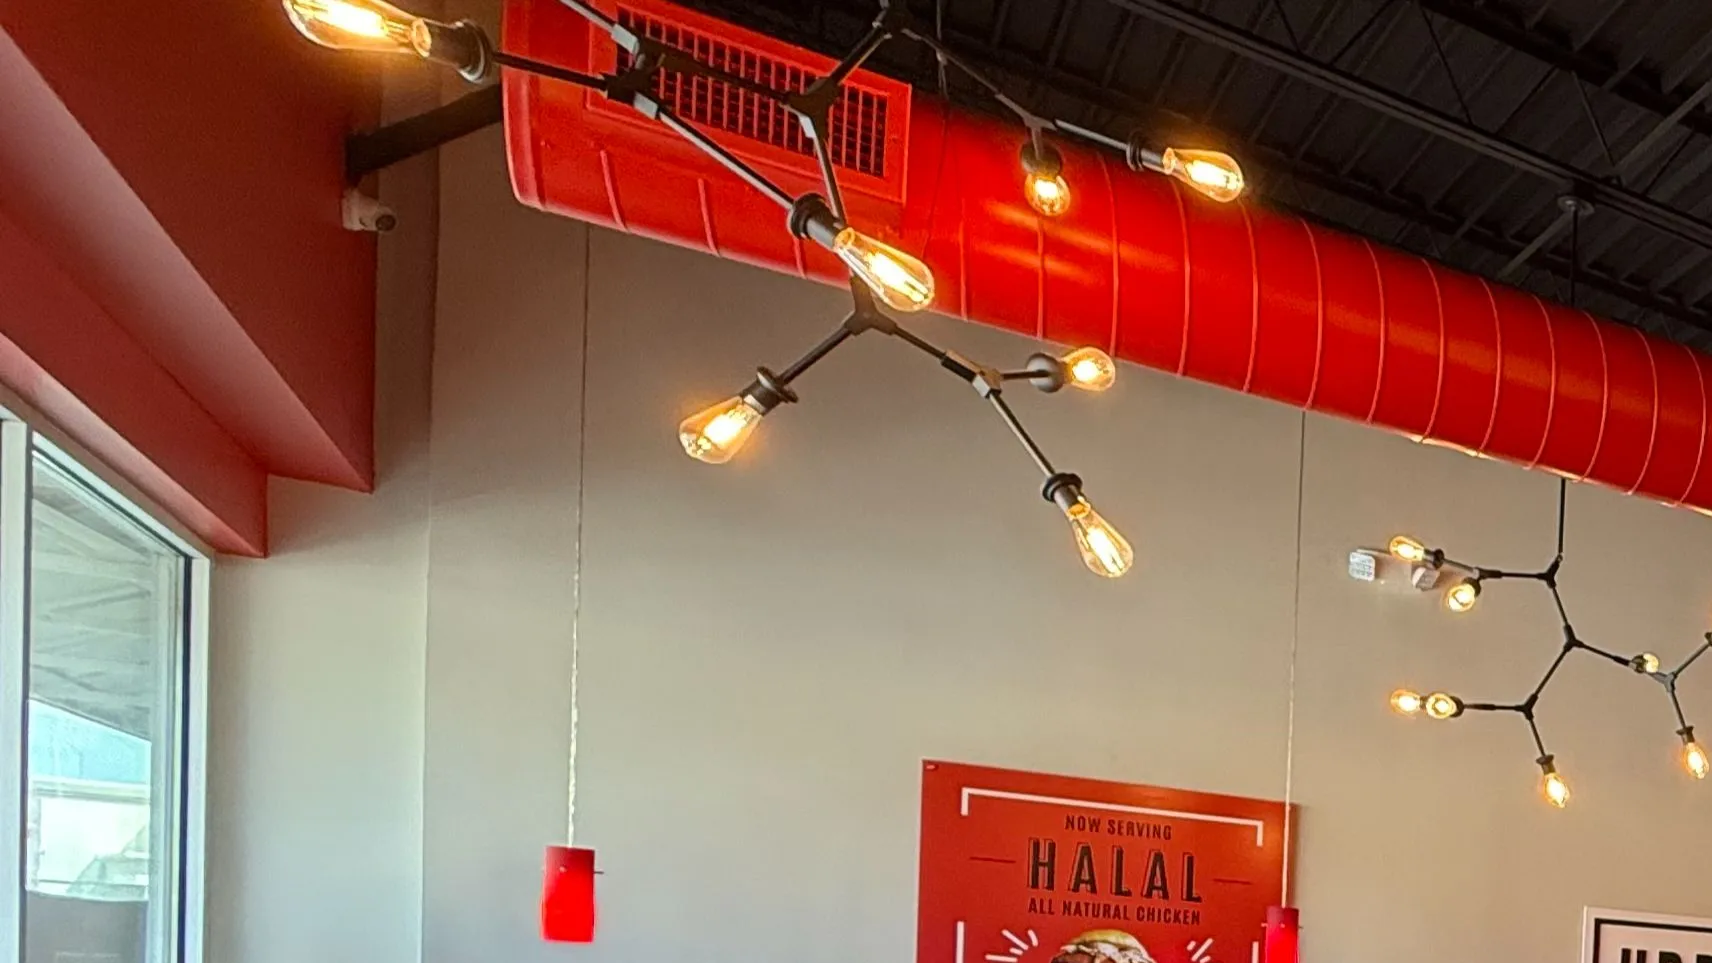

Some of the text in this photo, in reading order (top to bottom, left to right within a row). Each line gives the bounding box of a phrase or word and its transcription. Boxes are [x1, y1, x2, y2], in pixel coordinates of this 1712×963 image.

[1065, 814, 1172, 840] NOW SERVING
[1027, 837, 1203, 903] HALAL
[1028, 897, 1201, 926] ALL NATURAL CHICKEN
